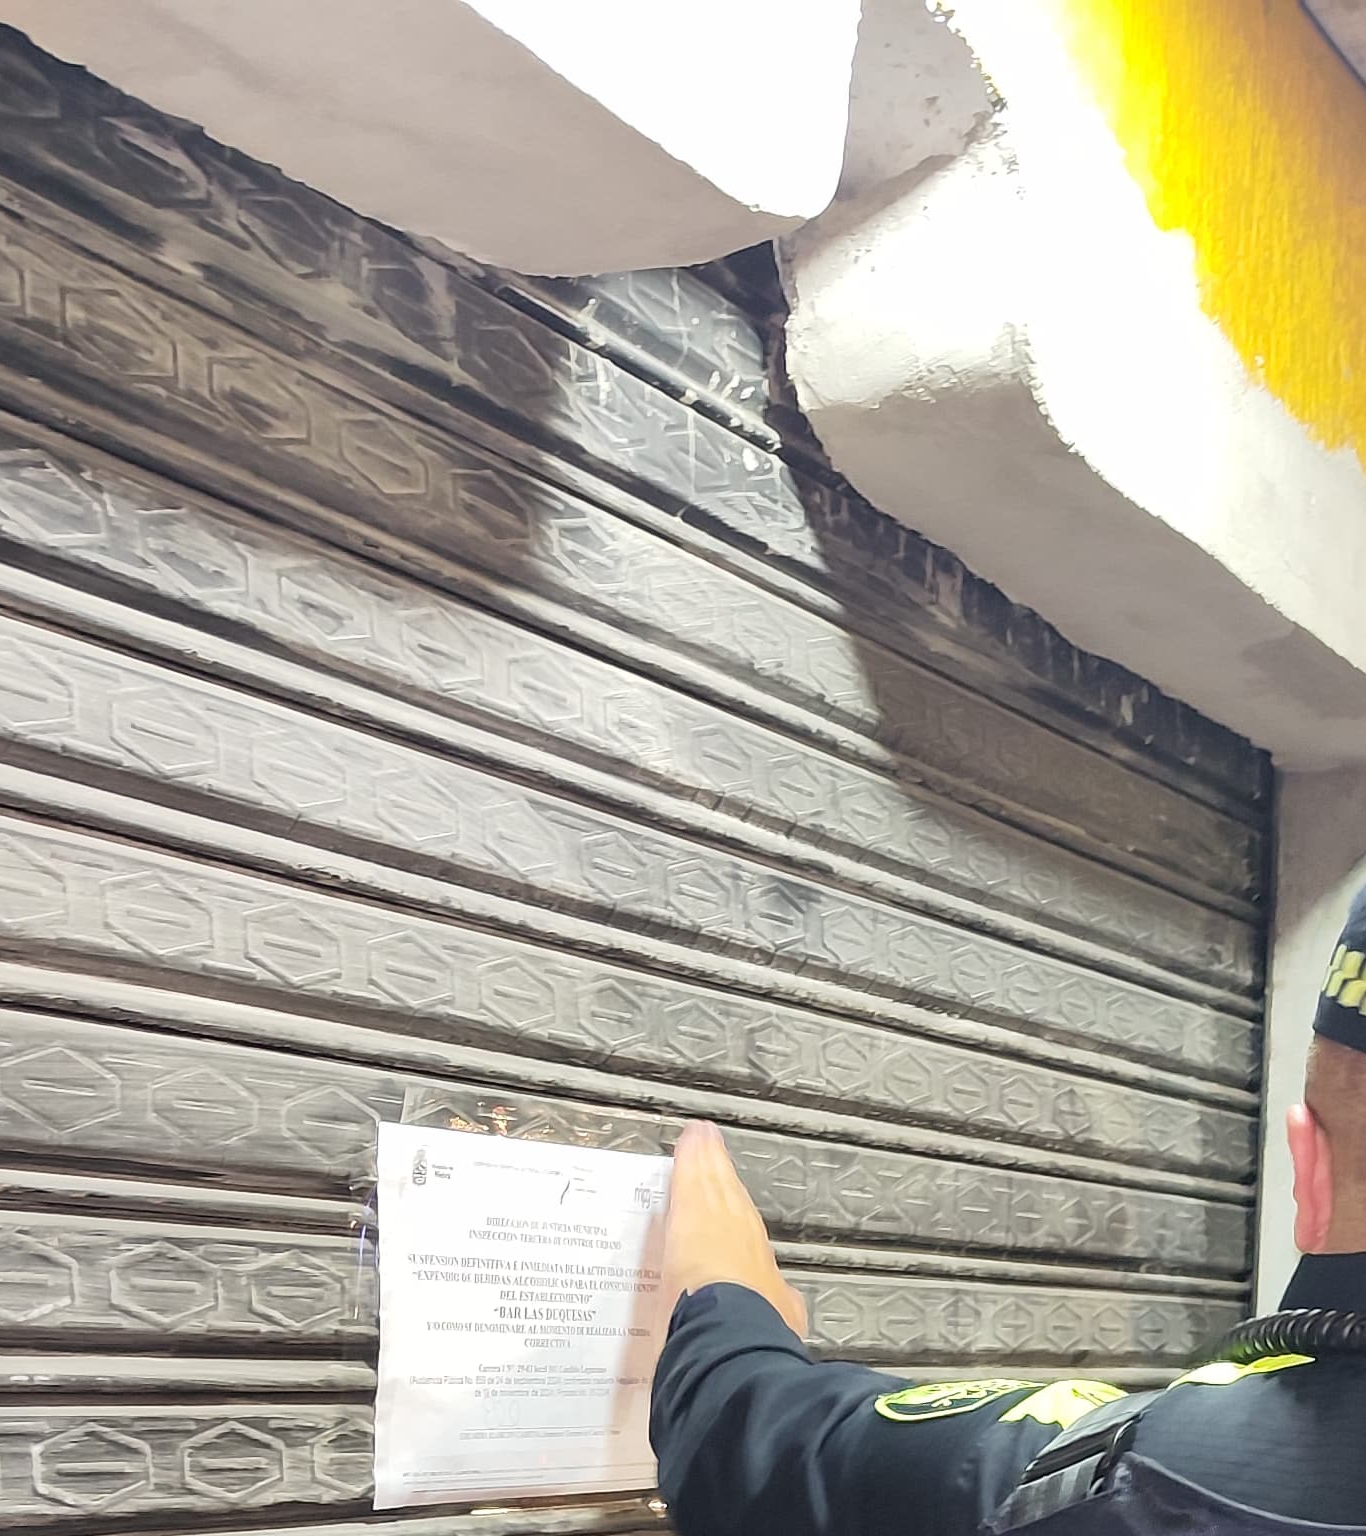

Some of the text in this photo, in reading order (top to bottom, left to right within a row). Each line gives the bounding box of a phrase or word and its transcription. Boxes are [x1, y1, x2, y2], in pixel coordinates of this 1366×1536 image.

[460, 1257, 511, 1270] DEFINITIVA
[499, 1290, 517, 1301] DEL
[524, 1306, 544, 1321] LAS
